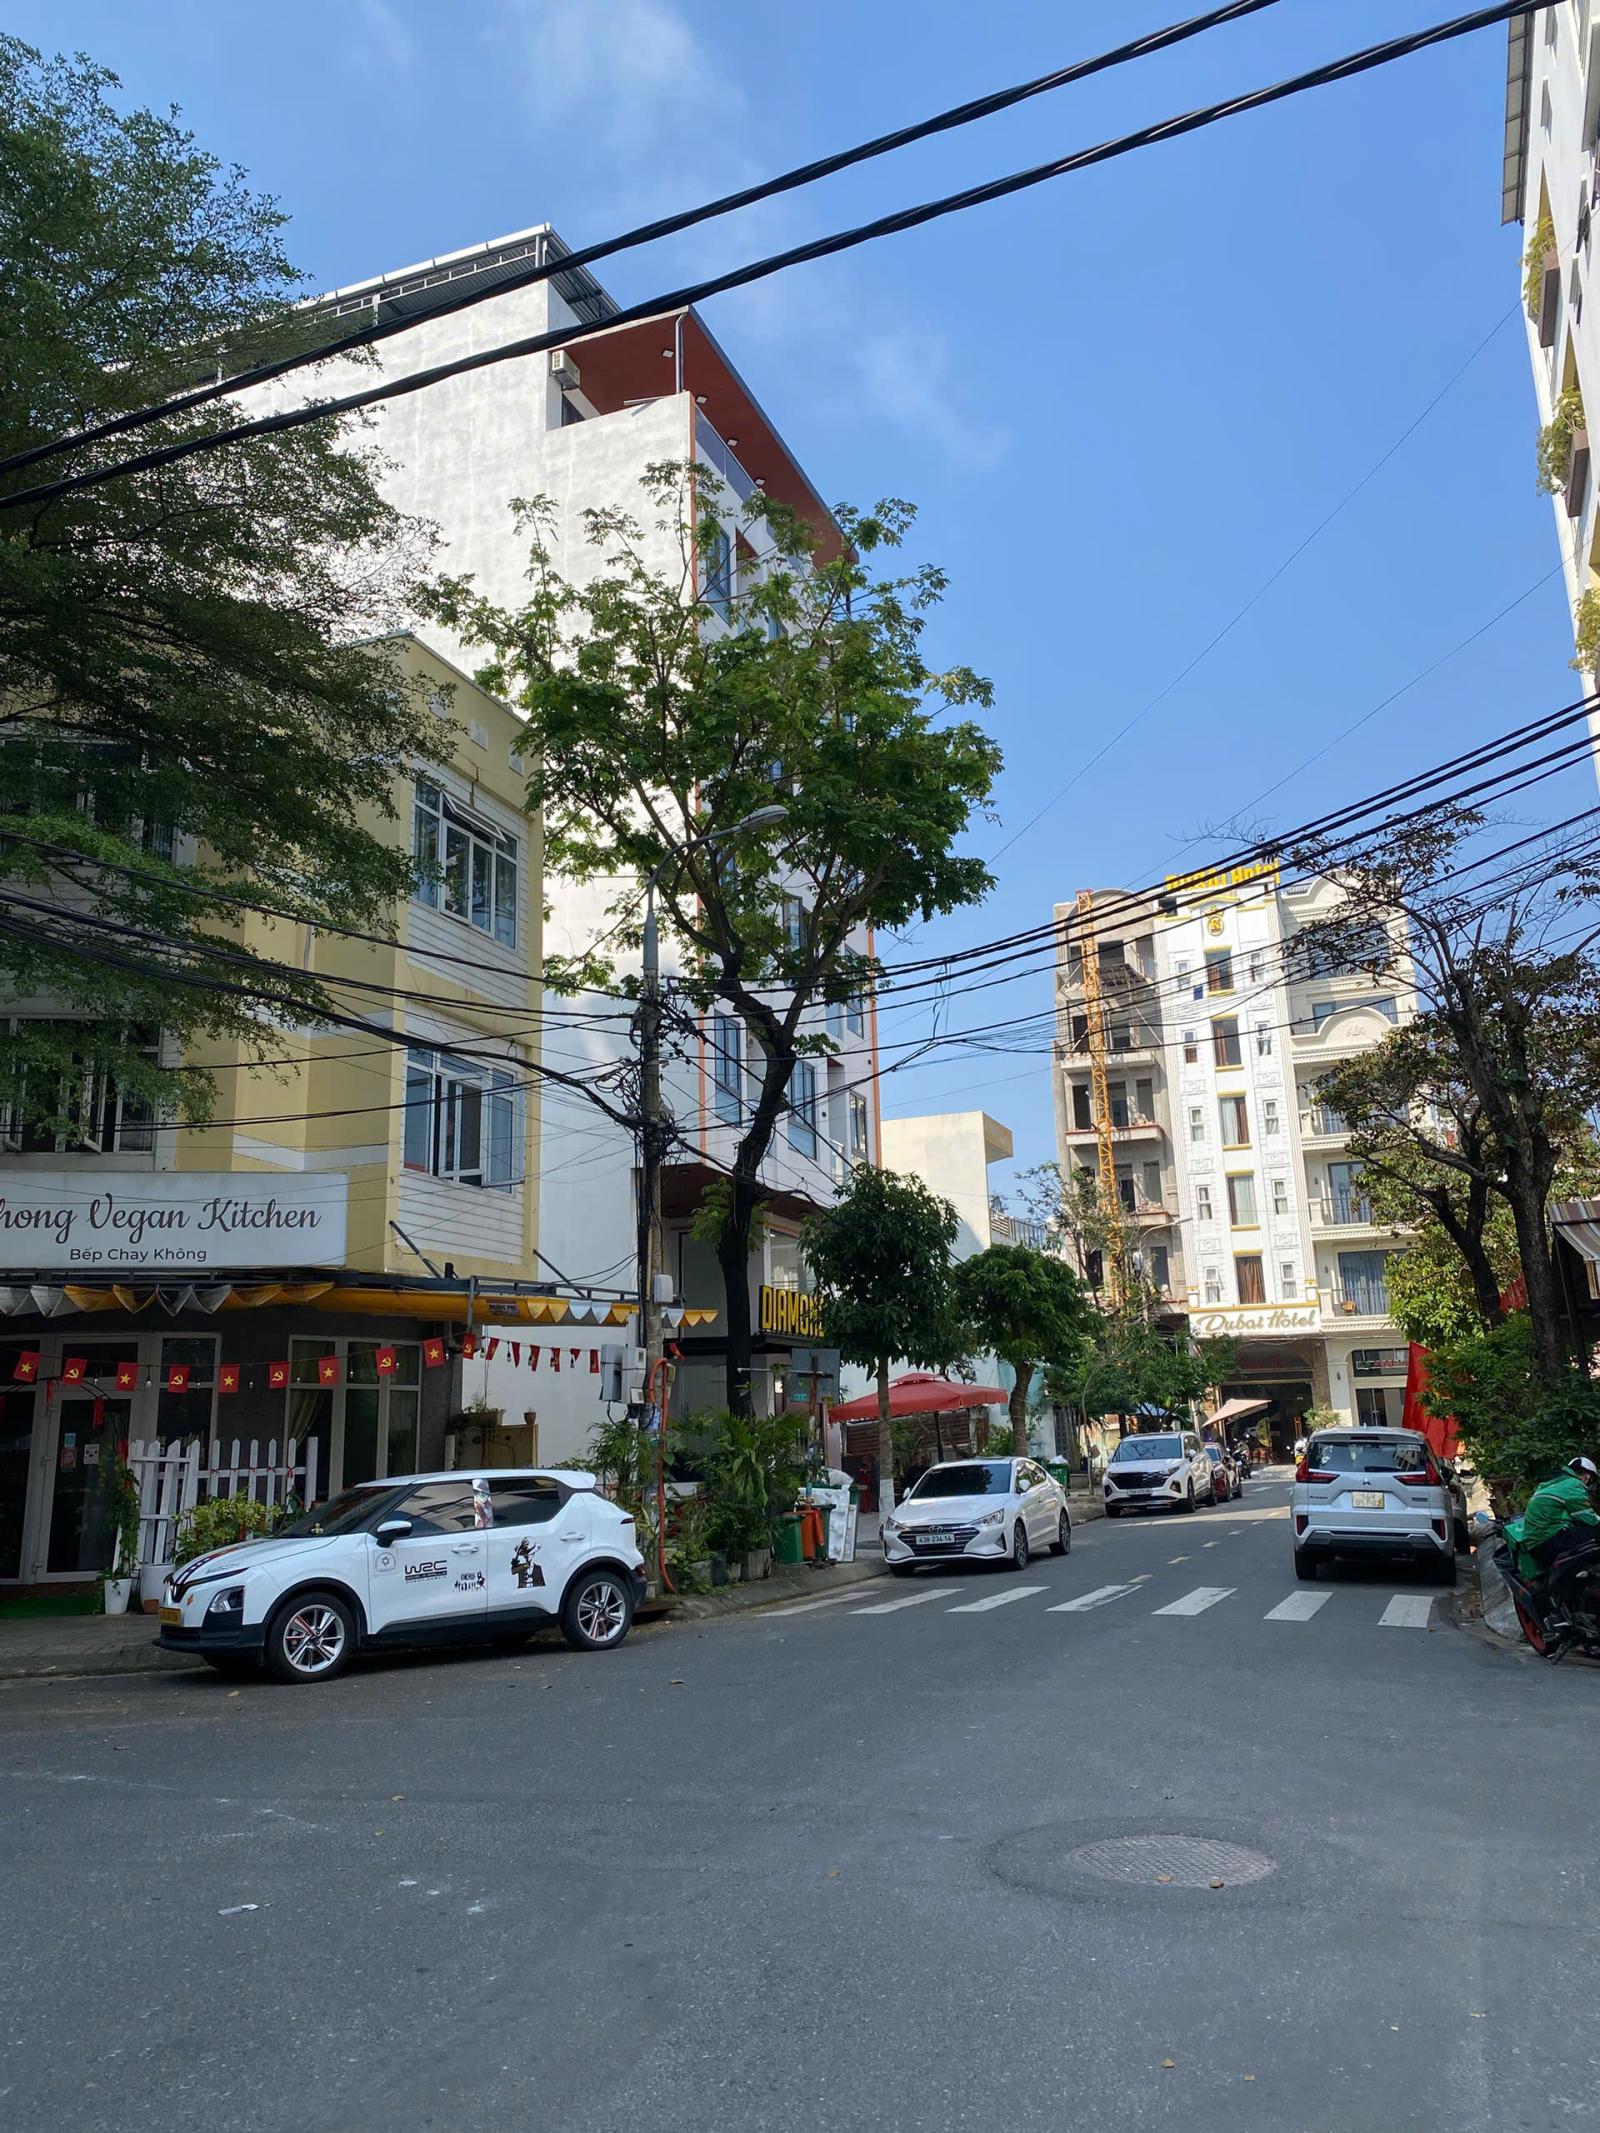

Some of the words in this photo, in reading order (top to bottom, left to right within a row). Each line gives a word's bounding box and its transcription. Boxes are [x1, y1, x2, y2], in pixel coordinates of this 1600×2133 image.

[86, 1192, 190, 1244] Vegan
[197, 1197, 321, 1232] Kitchen
[70, 1246, 103, 1262] Bếp
[107, 1248, 149, 1263] Chay
[154, 1247, 207, 1263] Không
[1197, 1312, 1264, 1332] Dubai
[1267, 1309, 1316, 1330] Hotel
[404, 1559, 448, 1575] WRC
